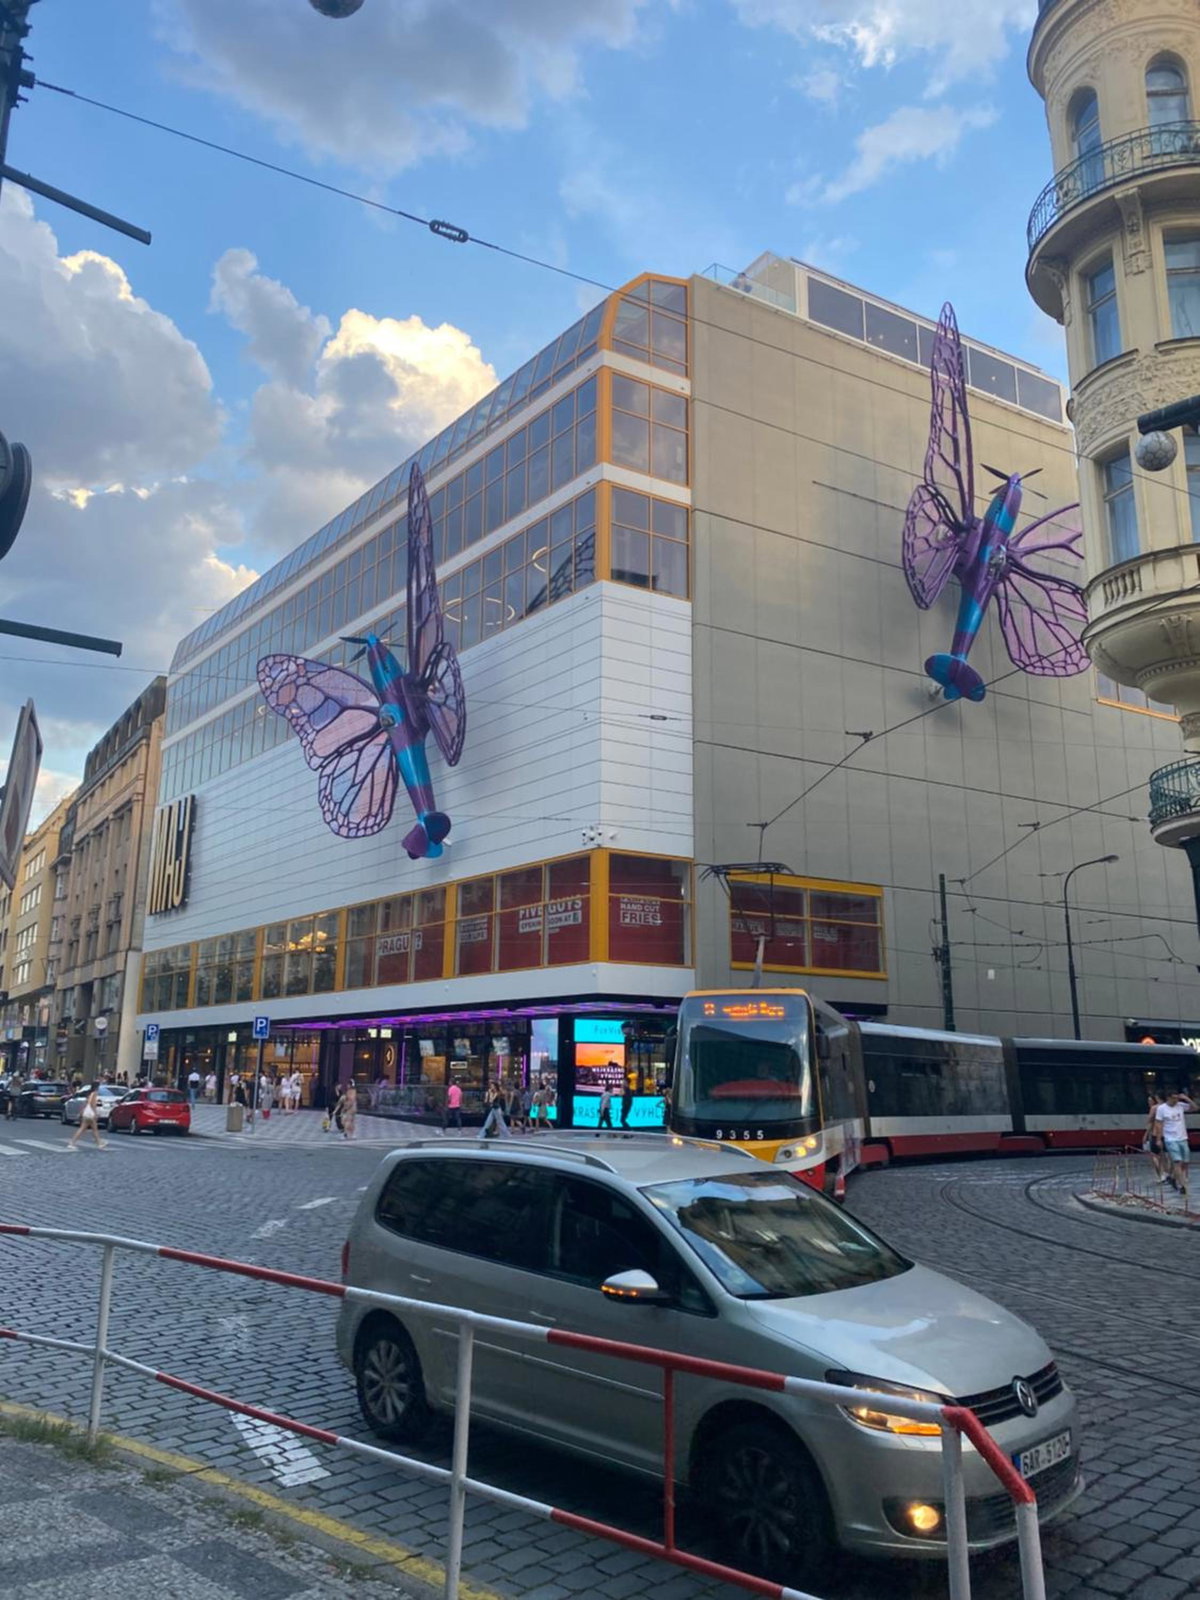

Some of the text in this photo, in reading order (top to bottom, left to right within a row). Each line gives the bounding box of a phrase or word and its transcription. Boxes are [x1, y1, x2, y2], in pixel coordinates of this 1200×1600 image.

[622, 911, 660, 925] FRIES
[148, 1025, 157, 1036] P
[257, 1018, 266, 1031] P
[716, 1129, 764, 1140] 9355
